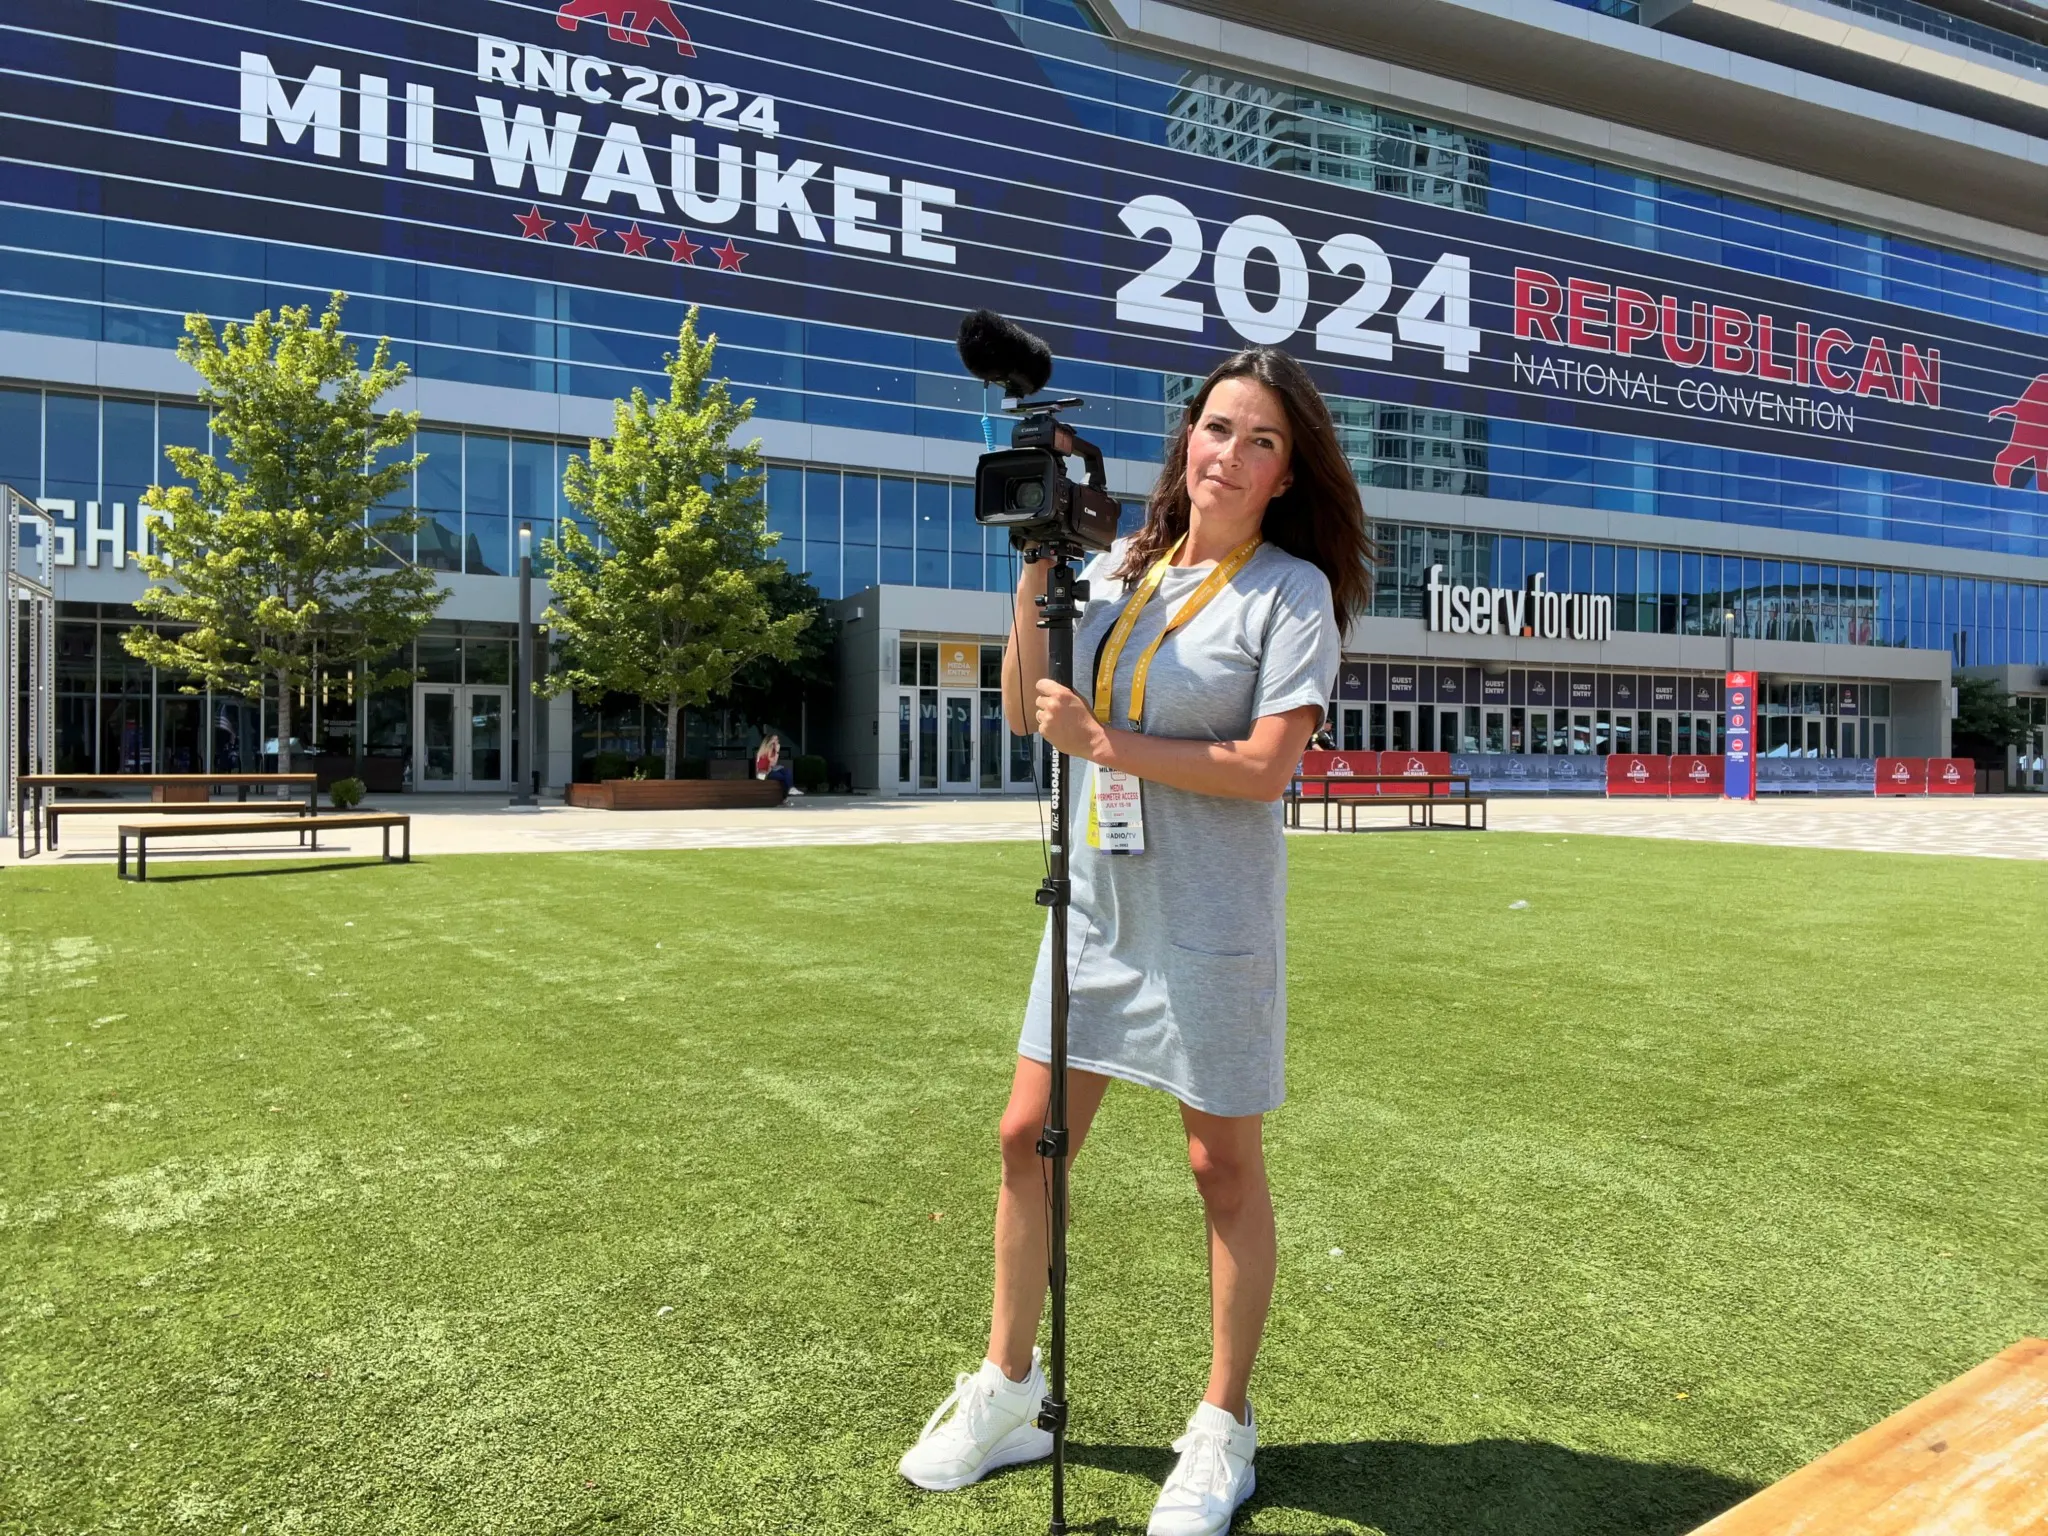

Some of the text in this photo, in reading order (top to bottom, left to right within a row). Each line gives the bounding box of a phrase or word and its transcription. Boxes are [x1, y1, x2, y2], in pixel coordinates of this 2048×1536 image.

[477, 33, 780, 139] RNC 2024
[240, 51, 956, 265] MILWAUKEE
[1116, 194, 1480, 373] 2024
[1514, 267, 1941, 409] REPUBLICAN
[1514, 352, 1855, 433] NATIONAL CONVENTION
[1391, 676, 1412, 684] GUEST
[1391, 683, 1412, 691] ENTRY
[1572, 690, 1591, 698] ENTRY
[1051, 744, 1060, 810] anfrotto
[1121, 792, 1139, 800] ACCESS
[1105, 832, 1136, 840] RADIO/TV
